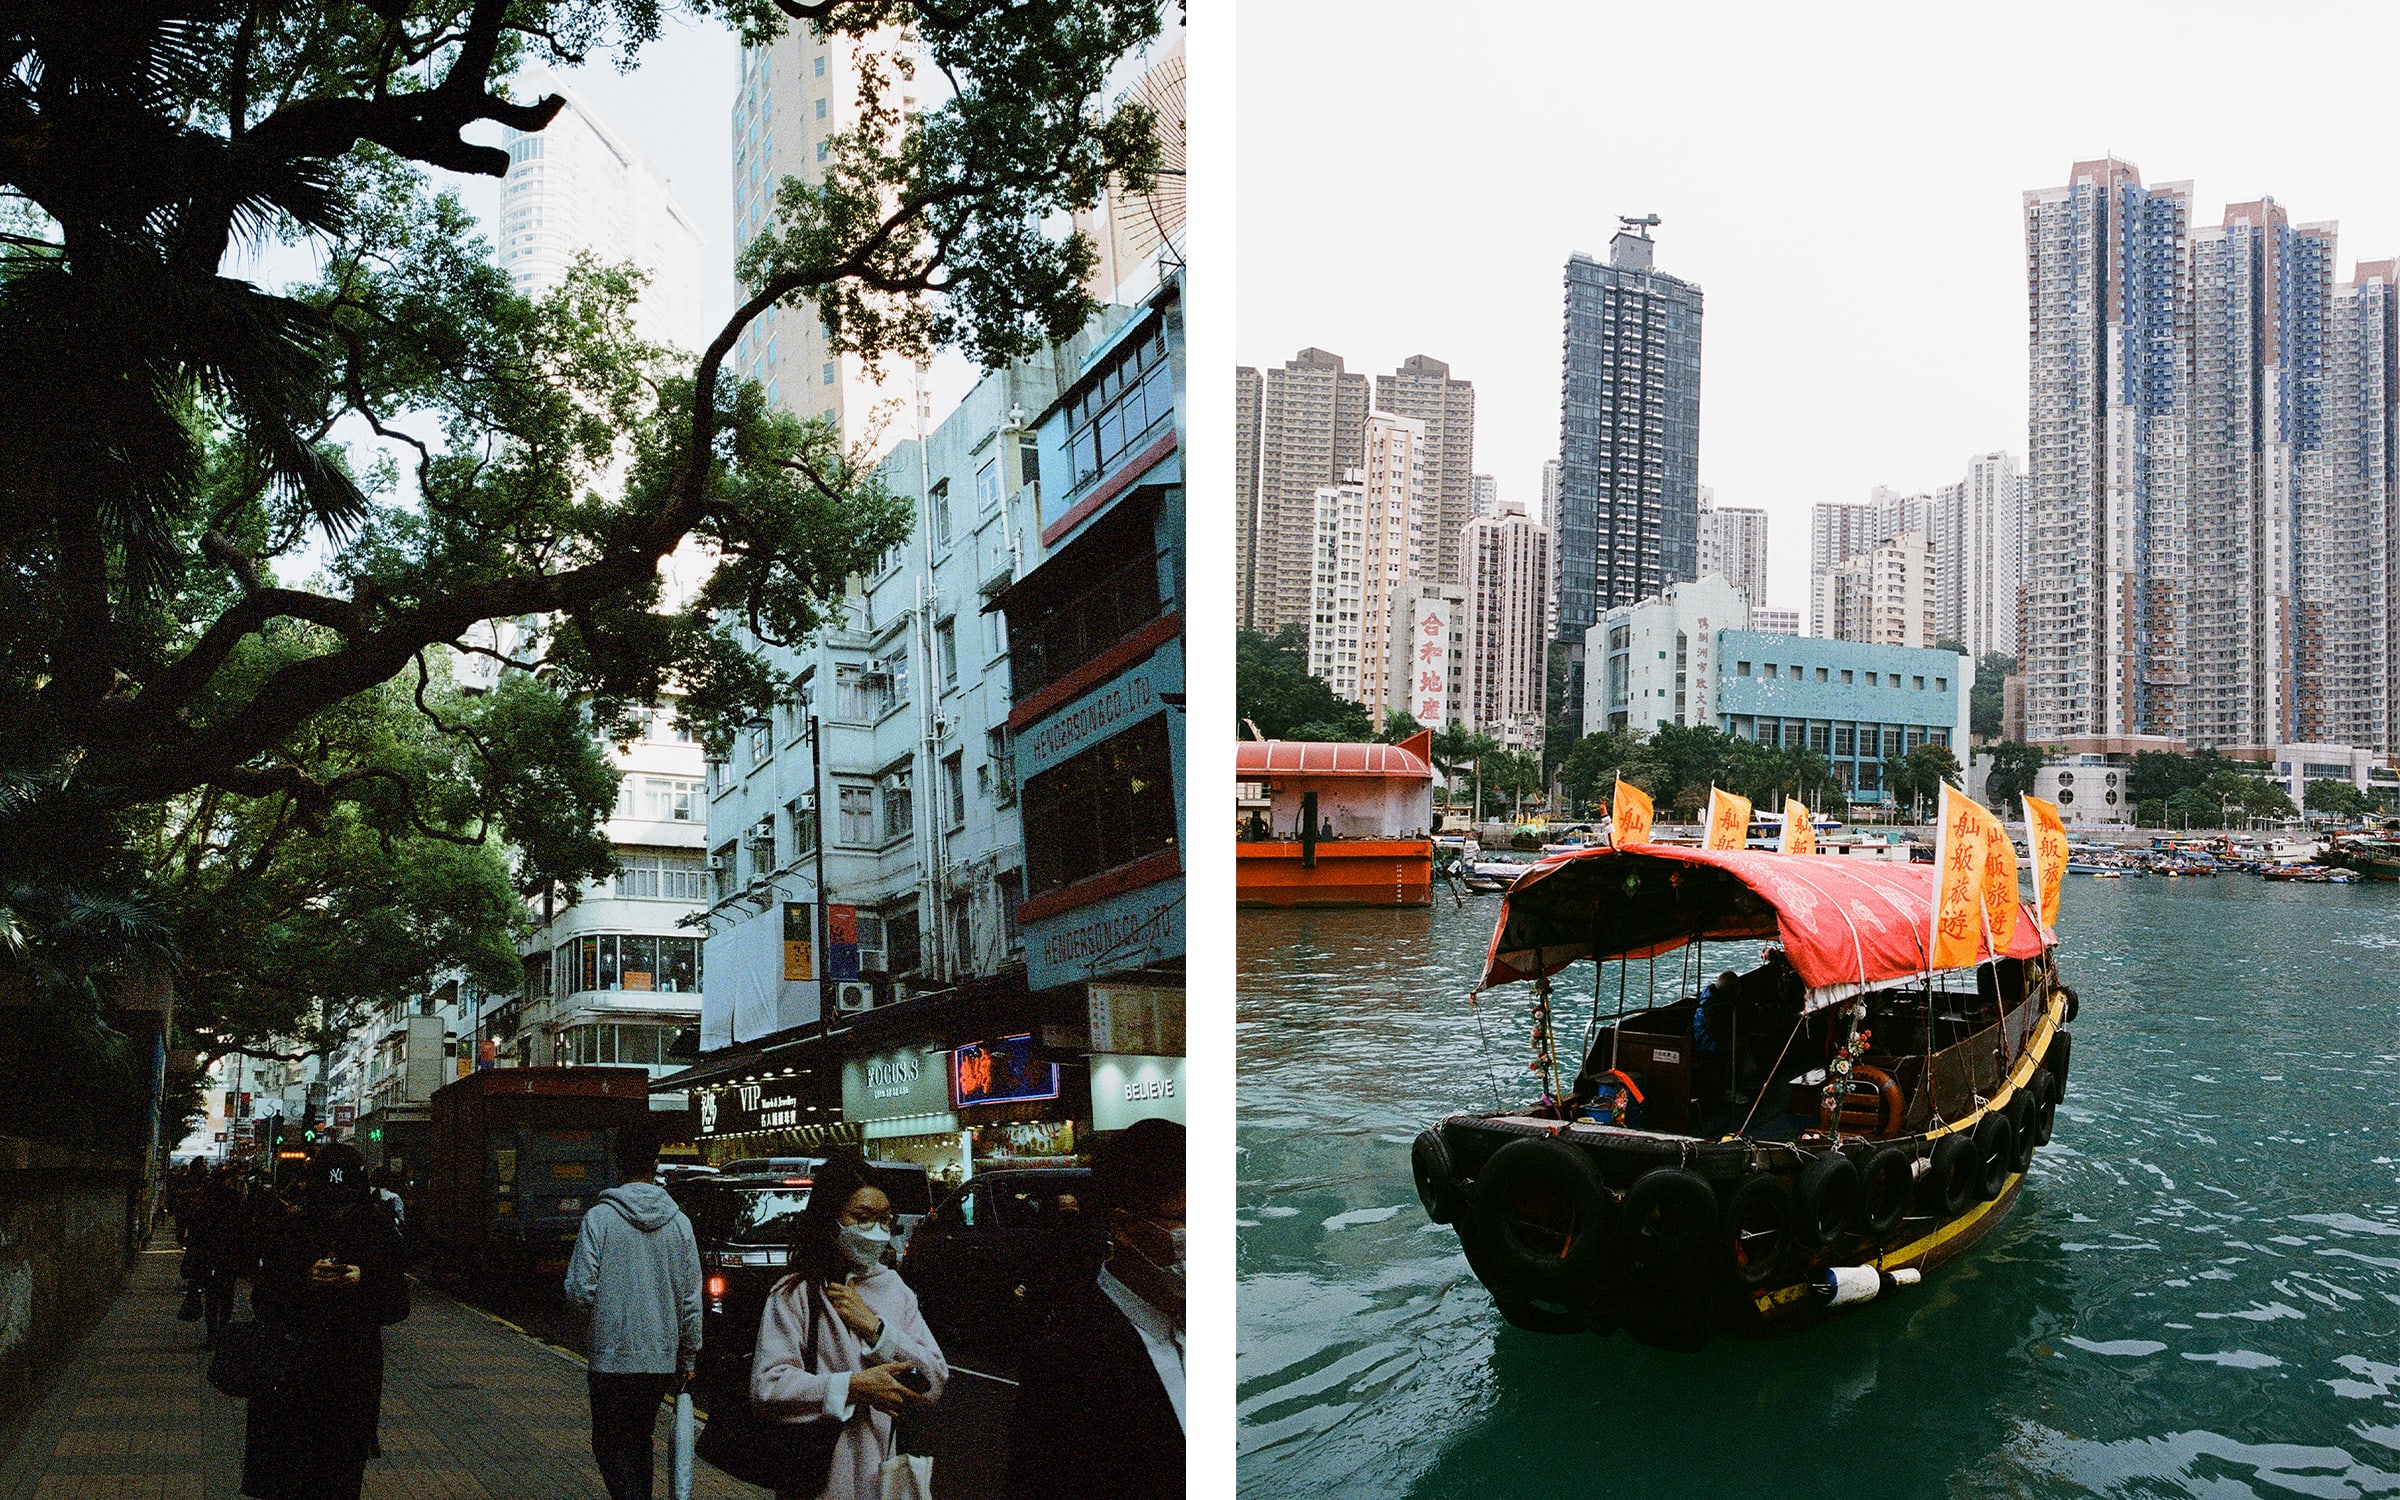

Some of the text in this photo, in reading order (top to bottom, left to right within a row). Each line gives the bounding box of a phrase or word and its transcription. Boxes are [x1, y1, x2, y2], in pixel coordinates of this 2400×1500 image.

[1417, 612, 1445, 720] 合和地產
[740, 1085, 761, 1112] VIP
[1125, 1079, 1175, 1101] BELIEVE
[329, 1167, 344, 1184] NY
